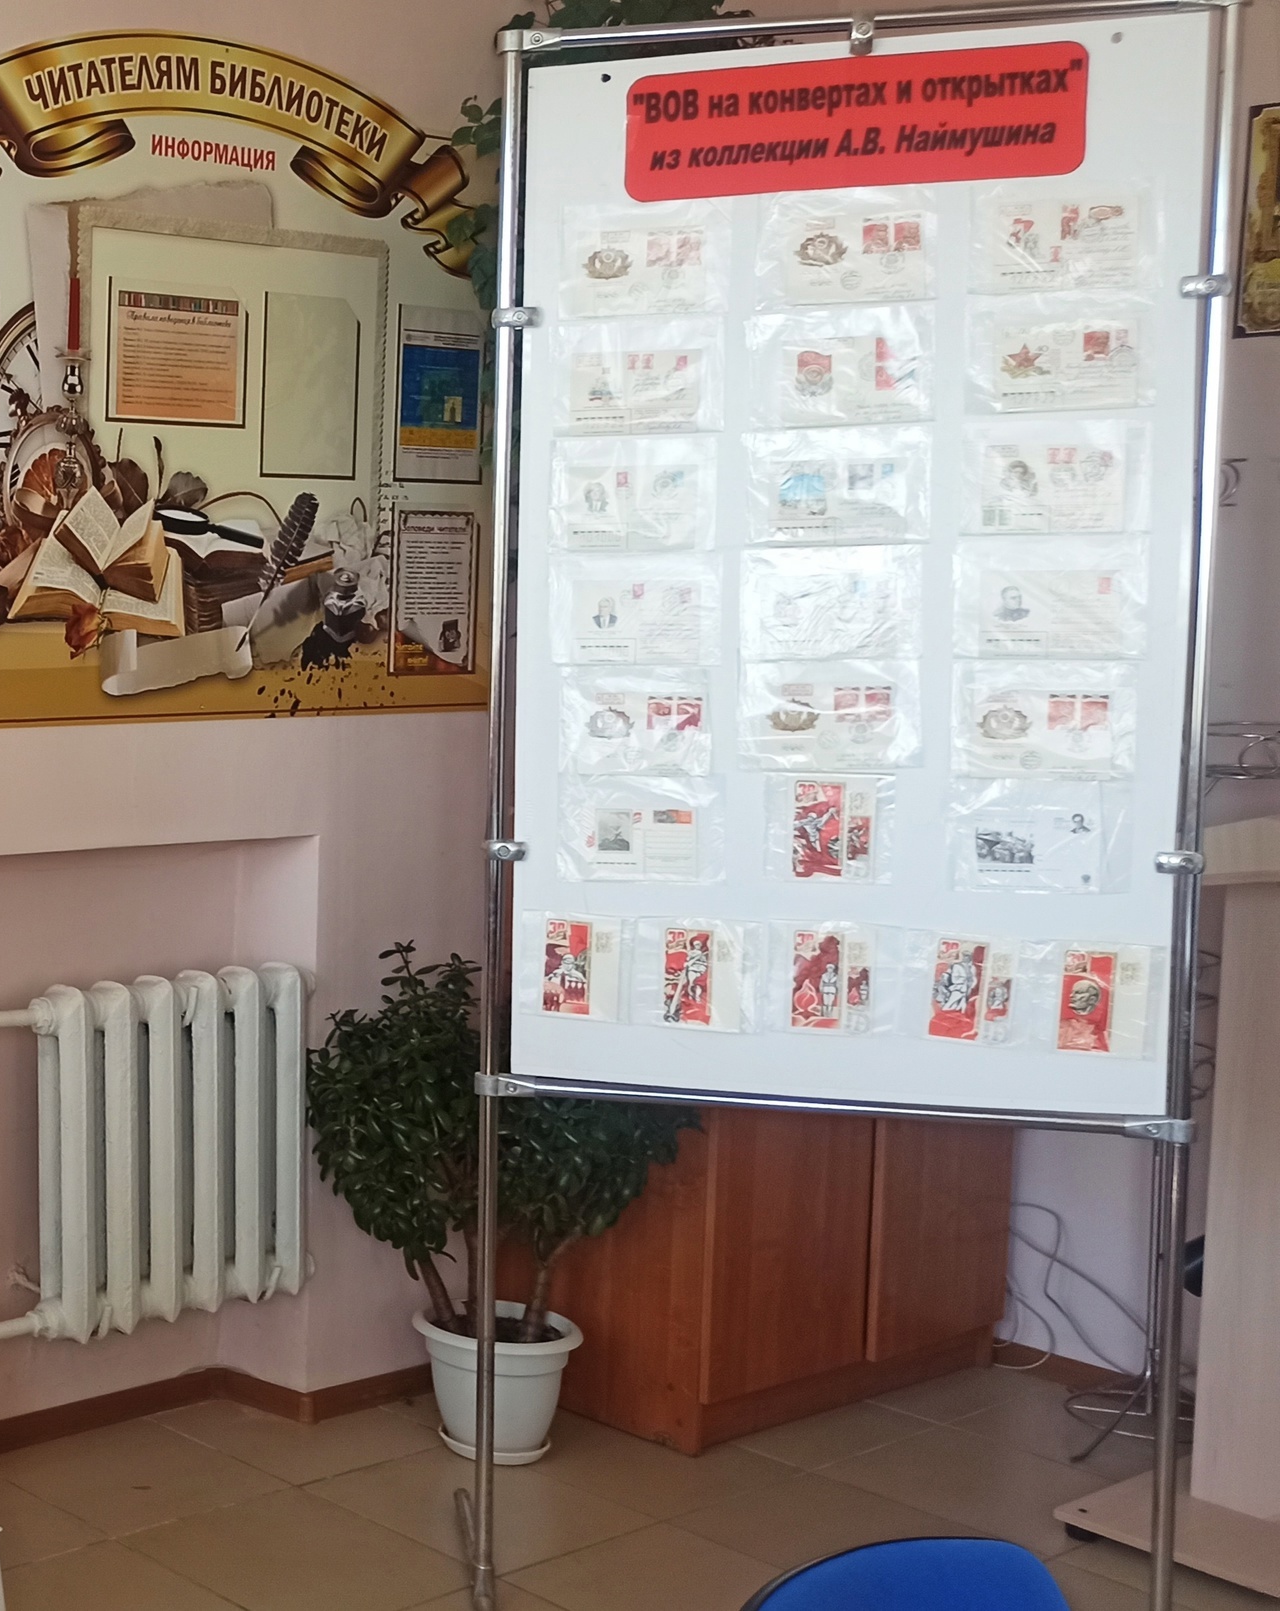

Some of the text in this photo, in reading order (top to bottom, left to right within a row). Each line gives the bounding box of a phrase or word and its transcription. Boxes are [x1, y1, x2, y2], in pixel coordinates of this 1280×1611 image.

[24, 54, 389, 163] ЧИТАТЕЛЯМ БИБЛИОТЕКИ
[632, 58, 1084, 124] "ВОВ на конвертах и открытках"
[151, 134, 277, 173] ИНФОРМАЦИЯ
[649, 119, 1057, 172] из коллекции А.В. Наймушина
